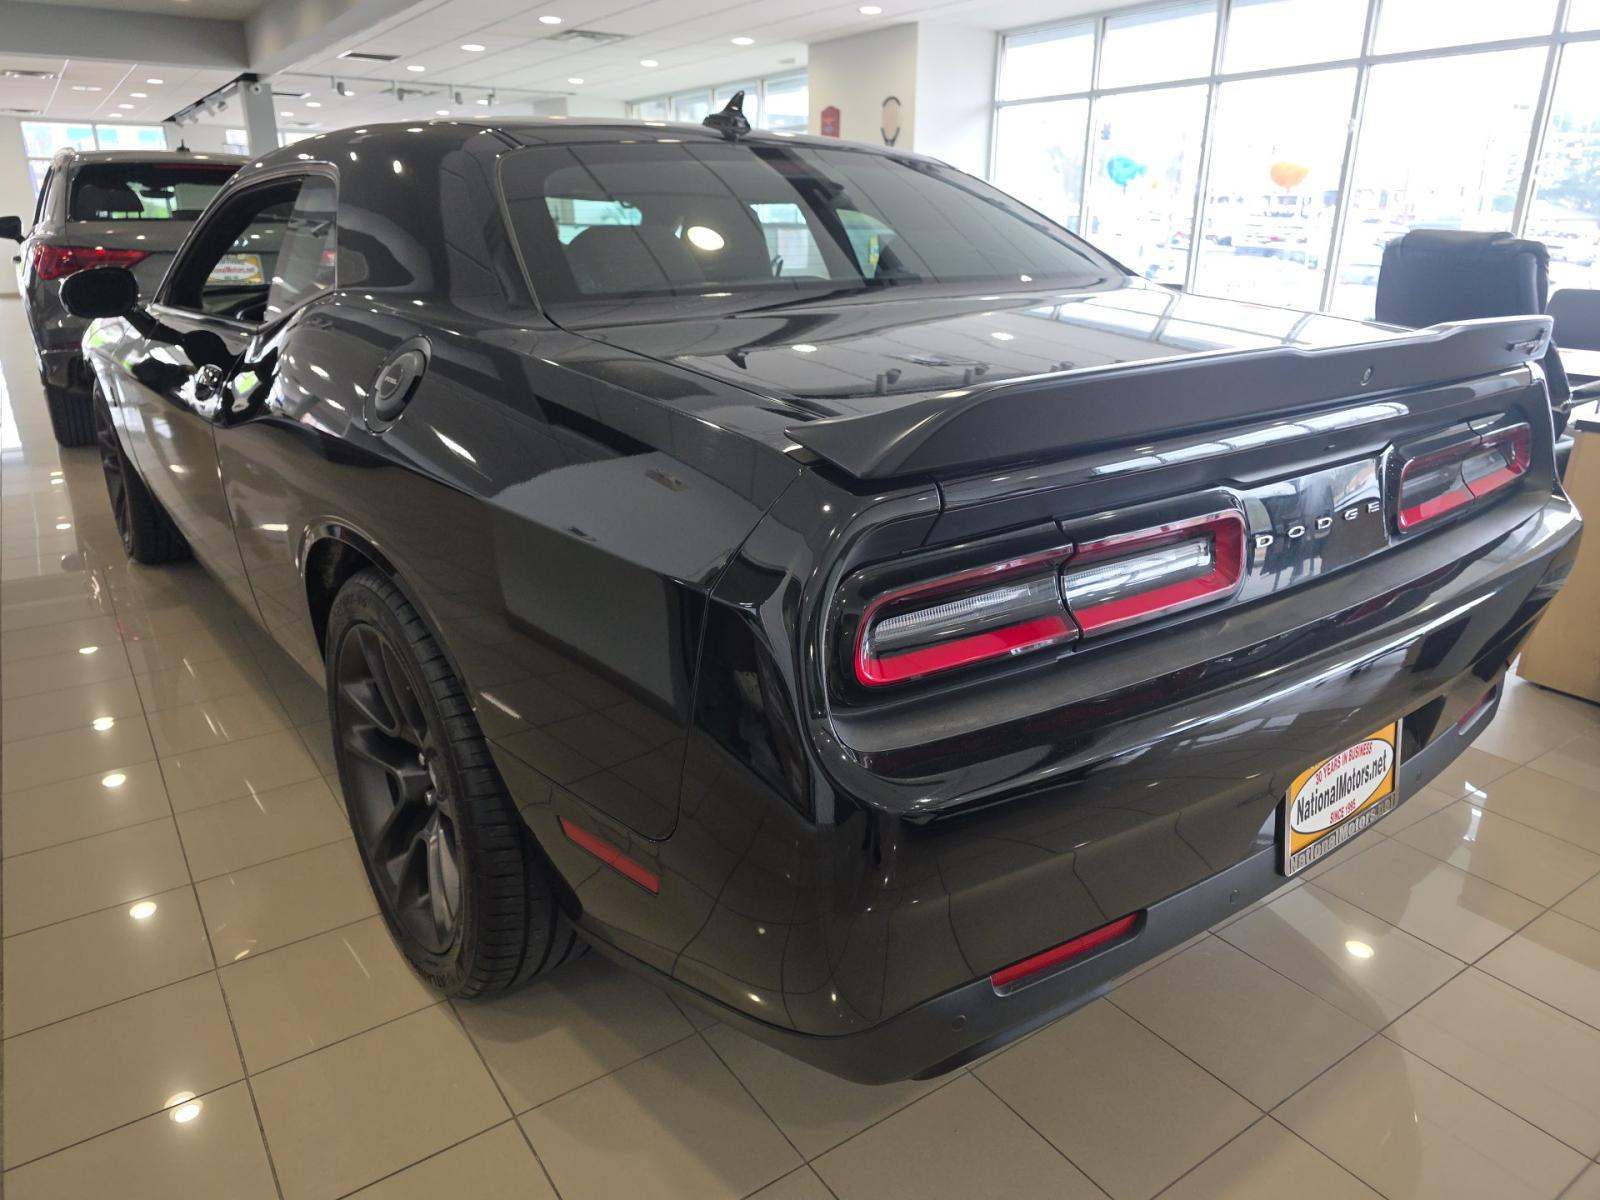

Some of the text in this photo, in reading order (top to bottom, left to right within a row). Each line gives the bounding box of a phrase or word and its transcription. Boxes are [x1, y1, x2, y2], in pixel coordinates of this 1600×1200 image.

[1255, 501, 1380, 548] DODGE
[1323, 756, 1341, 778] YEARS
[1341, 751, 1348, 765] IN
[1348, 741, 1373, 762] BUSINESS
[1296, 749, 1387, 826] NationalMotors.net
[1329, 807, 1344, 824] SINCE
